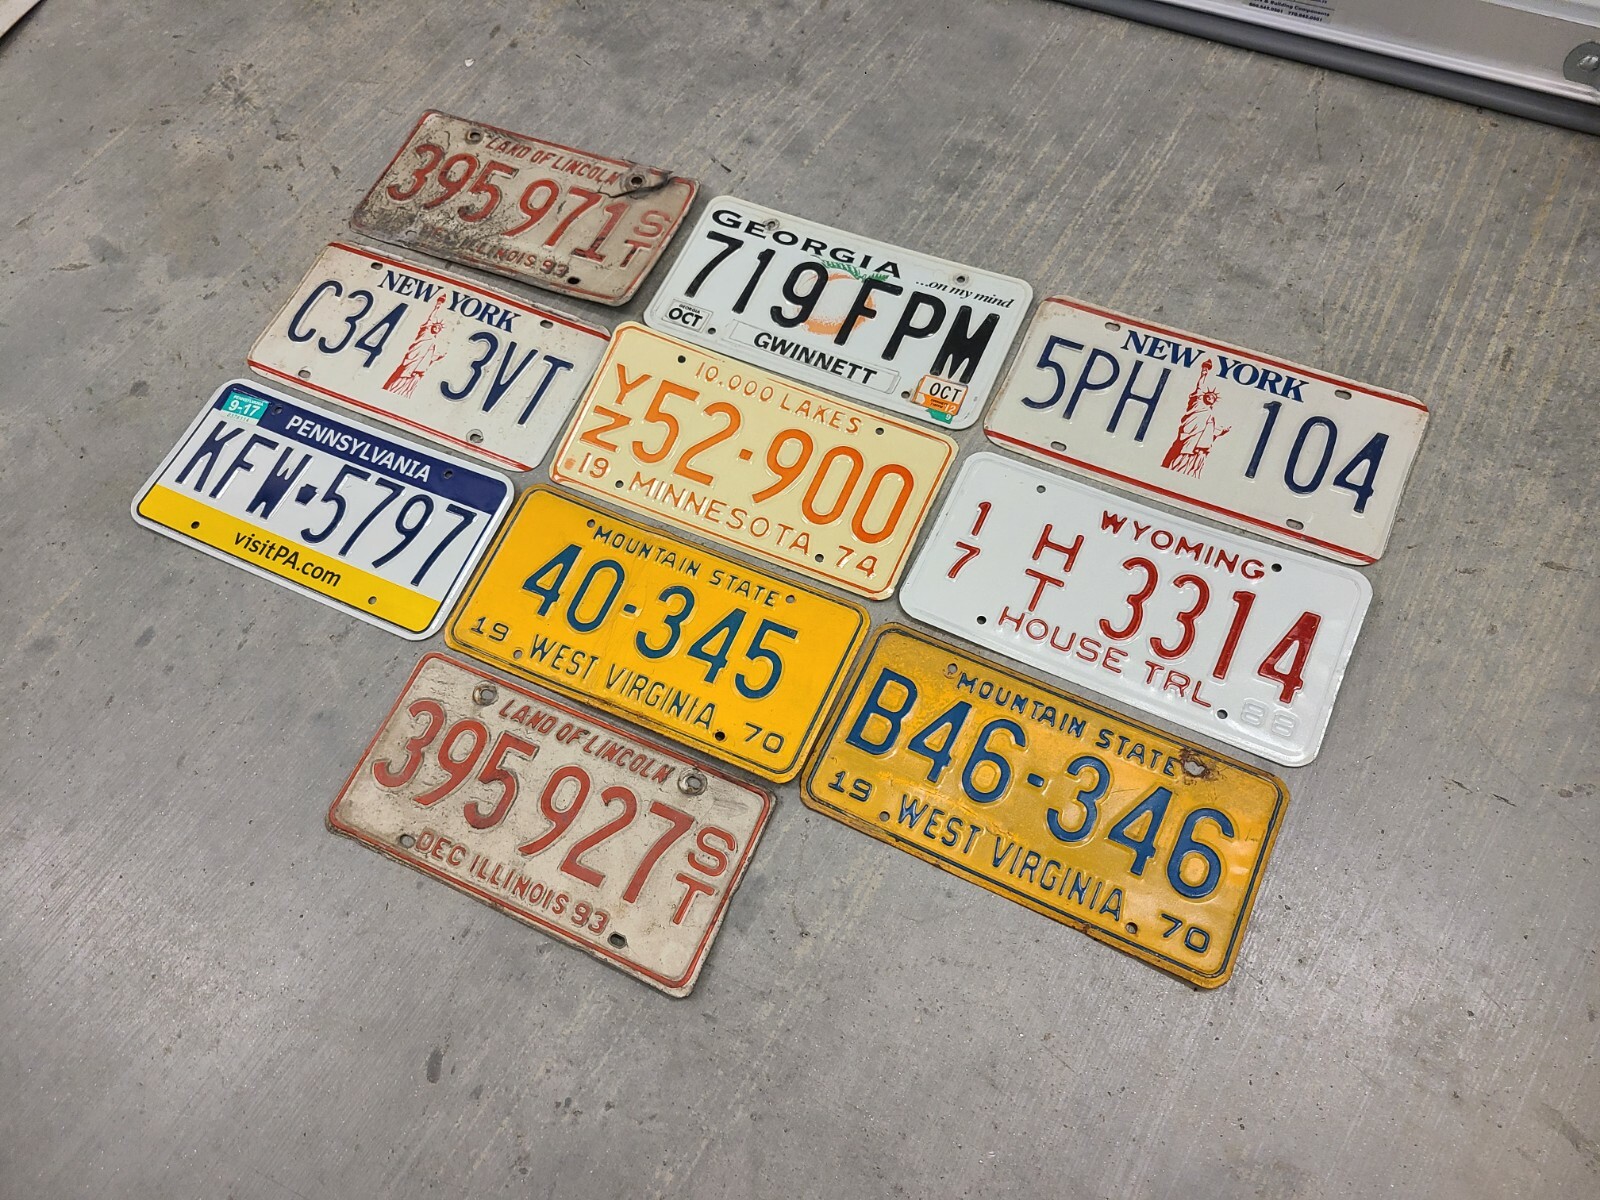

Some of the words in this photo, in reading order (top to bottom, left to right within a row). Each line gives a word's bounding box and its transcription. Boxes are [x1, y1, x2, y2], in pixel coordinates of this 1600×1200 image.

[1270, 0, 1294, 9] Building
[1294, 5, 1330, 17] Components
[485, 137, 532, 159] LAND
[530, 150, 556, 165] OF
[551, 156, 621, 186] LINCOLN
[387, 144, 517, 223] 395
[502, 178, 631, 263] 971
[540, 259, 569, 278] 93
[711, 209, 901, 279] GEORGIA
[377, 270, 445, 303] NEW
[446, 291, 522, 333] YORK
[669, 307, 704, 327] OCT
[949, 287, 973, 299] my
[973, 294, 1015, 309] mind
[287, 280, 409, 369] C34
[440, 332, 574, 427] 3VT
[753, 332, 878, 386] GWINNETT
[1120, 329, 1205, 370] NEW
[1215, 354, 1310, 403] YORK
[228, 400, 261, 416] 9-17
[780, 393, 862, 434] LAKES
[930, 382, 963, 402] OCT
[1021, 335, 1172, 442] 5PH
[1244, 400, 1389, 514] 104
[285, 415, 432, 483] PENNSYLVANIA
[577, 452, 611, 479] 19
[630, 471, 812, 556] MINNESOTA
[1100, 510, 1265, 580] WYOMING
[234, 530, 342, 588] visitPA.com
[594, 526, 702, 577] MOUNTAIN
[709, 570, 781, 607] STATE
[838, 545, 878, 578] 74
[470, 616, 511, 642] 19
[522, 543, 799, 700] 40-345
[1099, 556, 1322, 702] 3314
[529, 634, 600, 681] WEST
[607, 664, 717, 731] VIRGINIA
[998, 606, 1129, 670] HOUSE
[1144, 660, 1212, 709] TRL
[498, 700, 555, 734] LAND
[555, 723, 588, 748] OF
[583, 733, 674, 784] LINCOLN
[744, 723, 785, 755] 70
[958, 673, 1086, 738] MOUNTAIN
[1096, 730, 1177, 777] STATE
[372, 700, 537, 830] 395
[518, 766, 695, 904] 927
[828, 770, 874, 801] 19
[846, 668, 1235, 898] B46-346
[414, 830, 462, 867] DEC
[471, 855, 571, 916] ILLINOIS
[571, 903, 611, 935] 93
[897, 793, 980, 855] WEST
[993, 838, 1123, 922] VIRGINIA
[1160, 914, 1211, 953] 70
